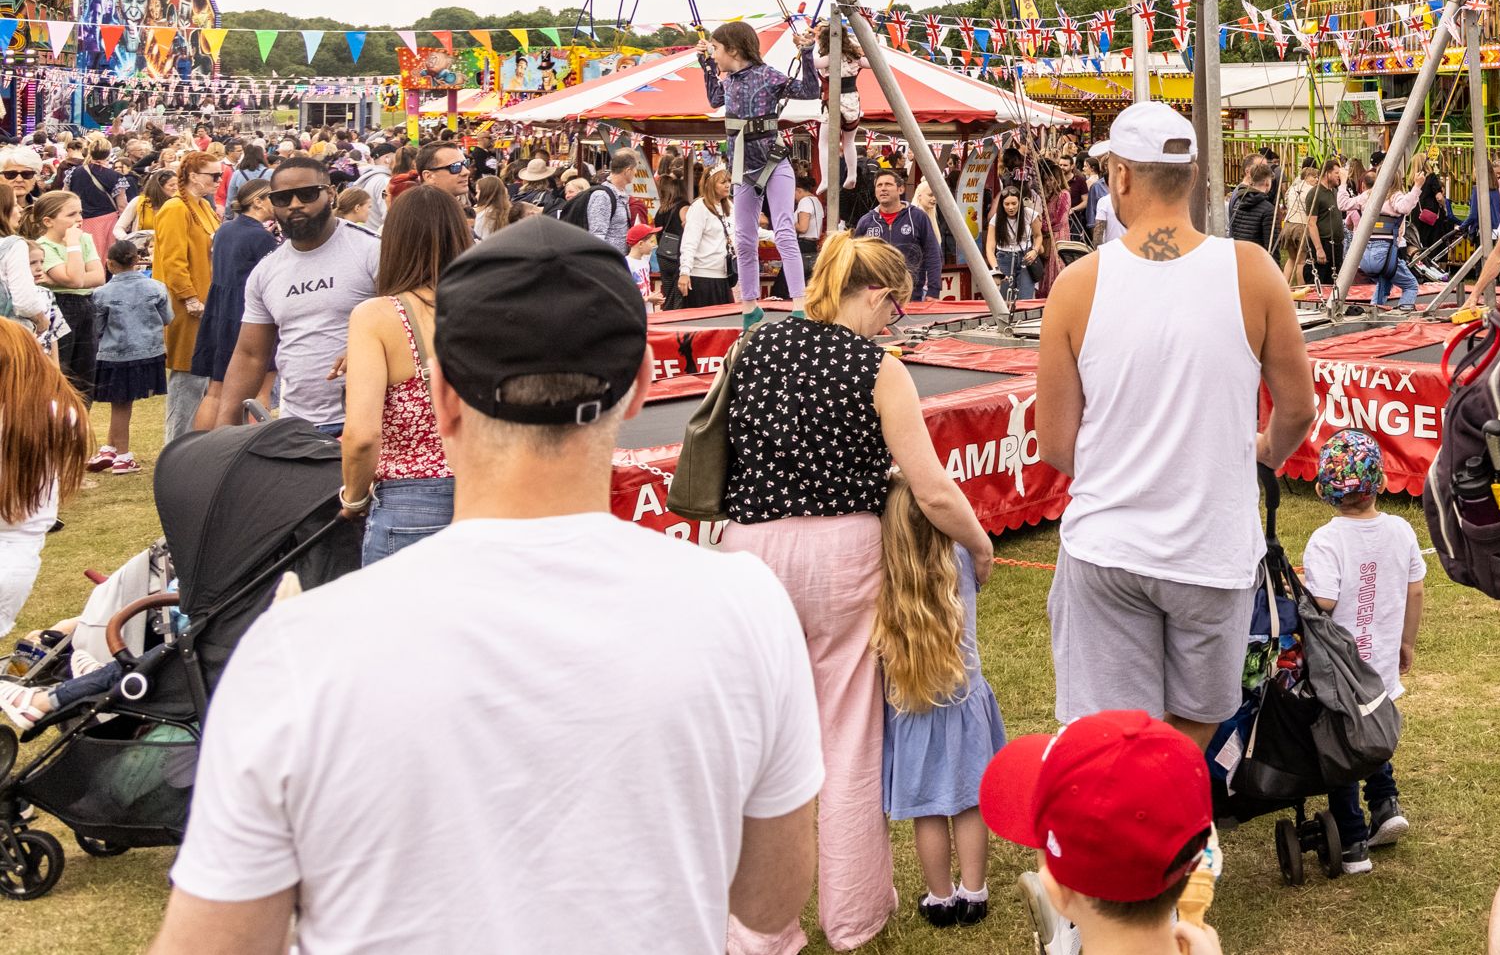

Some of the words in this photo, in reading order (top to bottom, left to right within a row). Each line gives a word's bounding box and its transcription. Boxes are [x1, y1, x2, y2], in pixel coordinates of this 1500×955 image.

[966, 177, 979, 187] ANY
[633, 183, 648, 193] ANY
[962, 192, 979, 203] PRIZE
[285, 276, 334, 298] AKAI
[1314, 393, 1446, 440] UNGE
